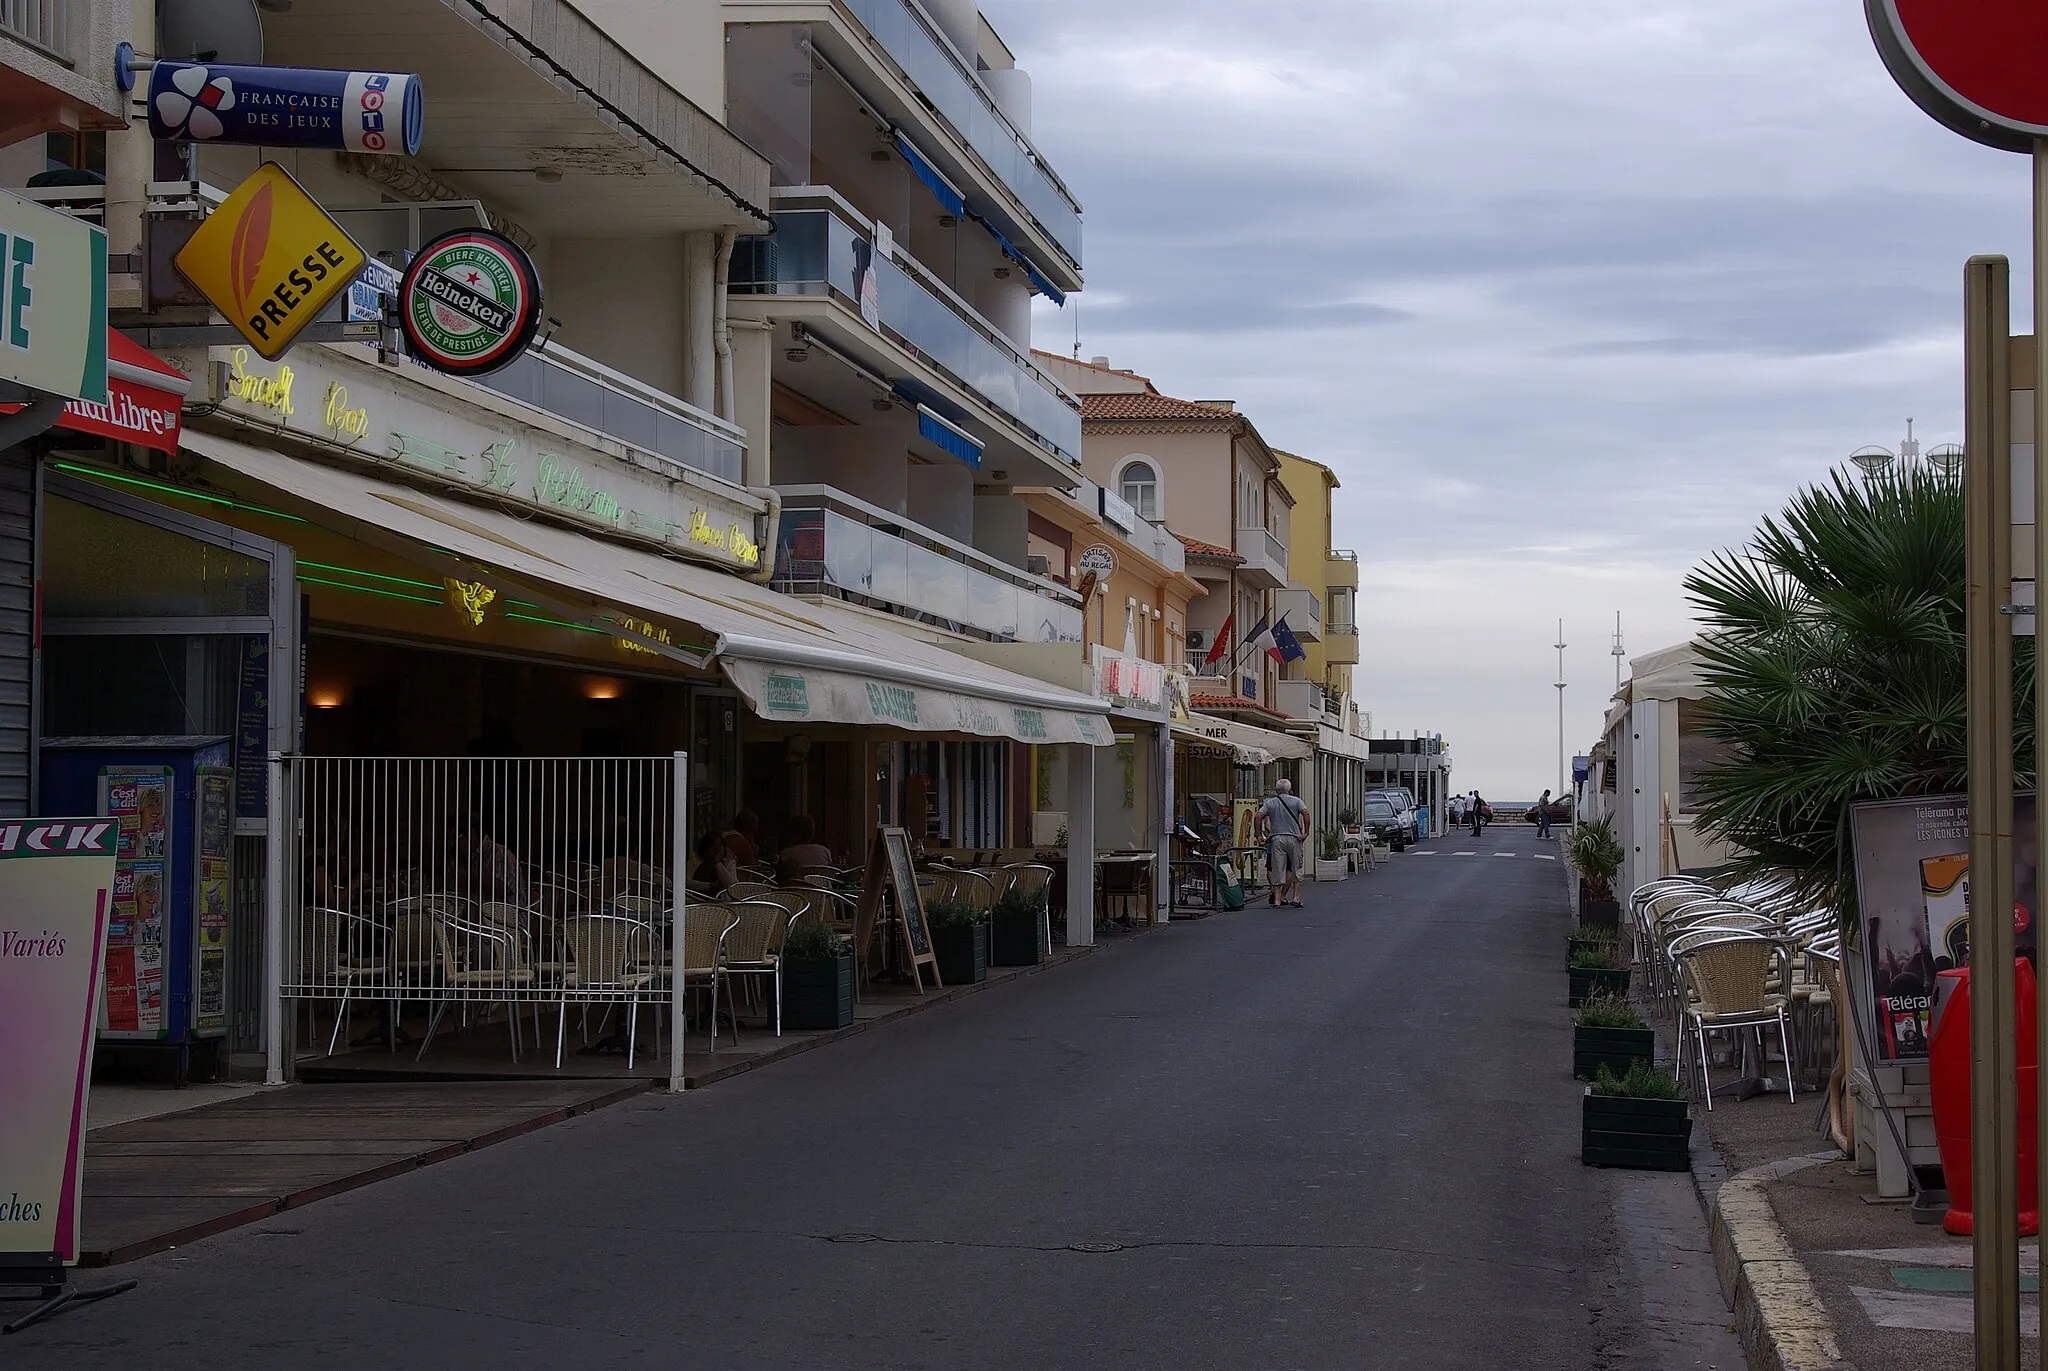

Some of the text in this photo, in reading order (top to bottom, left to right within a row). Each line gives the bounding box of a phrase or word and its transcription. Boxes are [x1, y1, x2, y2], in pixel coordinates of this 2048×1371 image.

[240, 92, 340, 110] FRANÇAISE
[361, 74, 390, 151] LOTO
[247, 112, 332, 129] DES JEUX
[445, 250, 475, 264] BIERE
[476, 252, 512, 292] HEINEKEN
[249, 241, 345, 342] PRESSE
[421, 273, 504, 328] Heineken
[416, 302, 489, 351] BIERE DE PRESTIGE
[326, 385, 370, 438] Bar
[1080, 560, 1090, 568] AU
[1082, 548, 1112, 563] ARTISAN
[1205, 728, 1228, 738] MER
[1915, 807, 1954, 818] Télérama
[1917, 830, 1931, 841] LES
[2, 929, 67, 958] Variés
